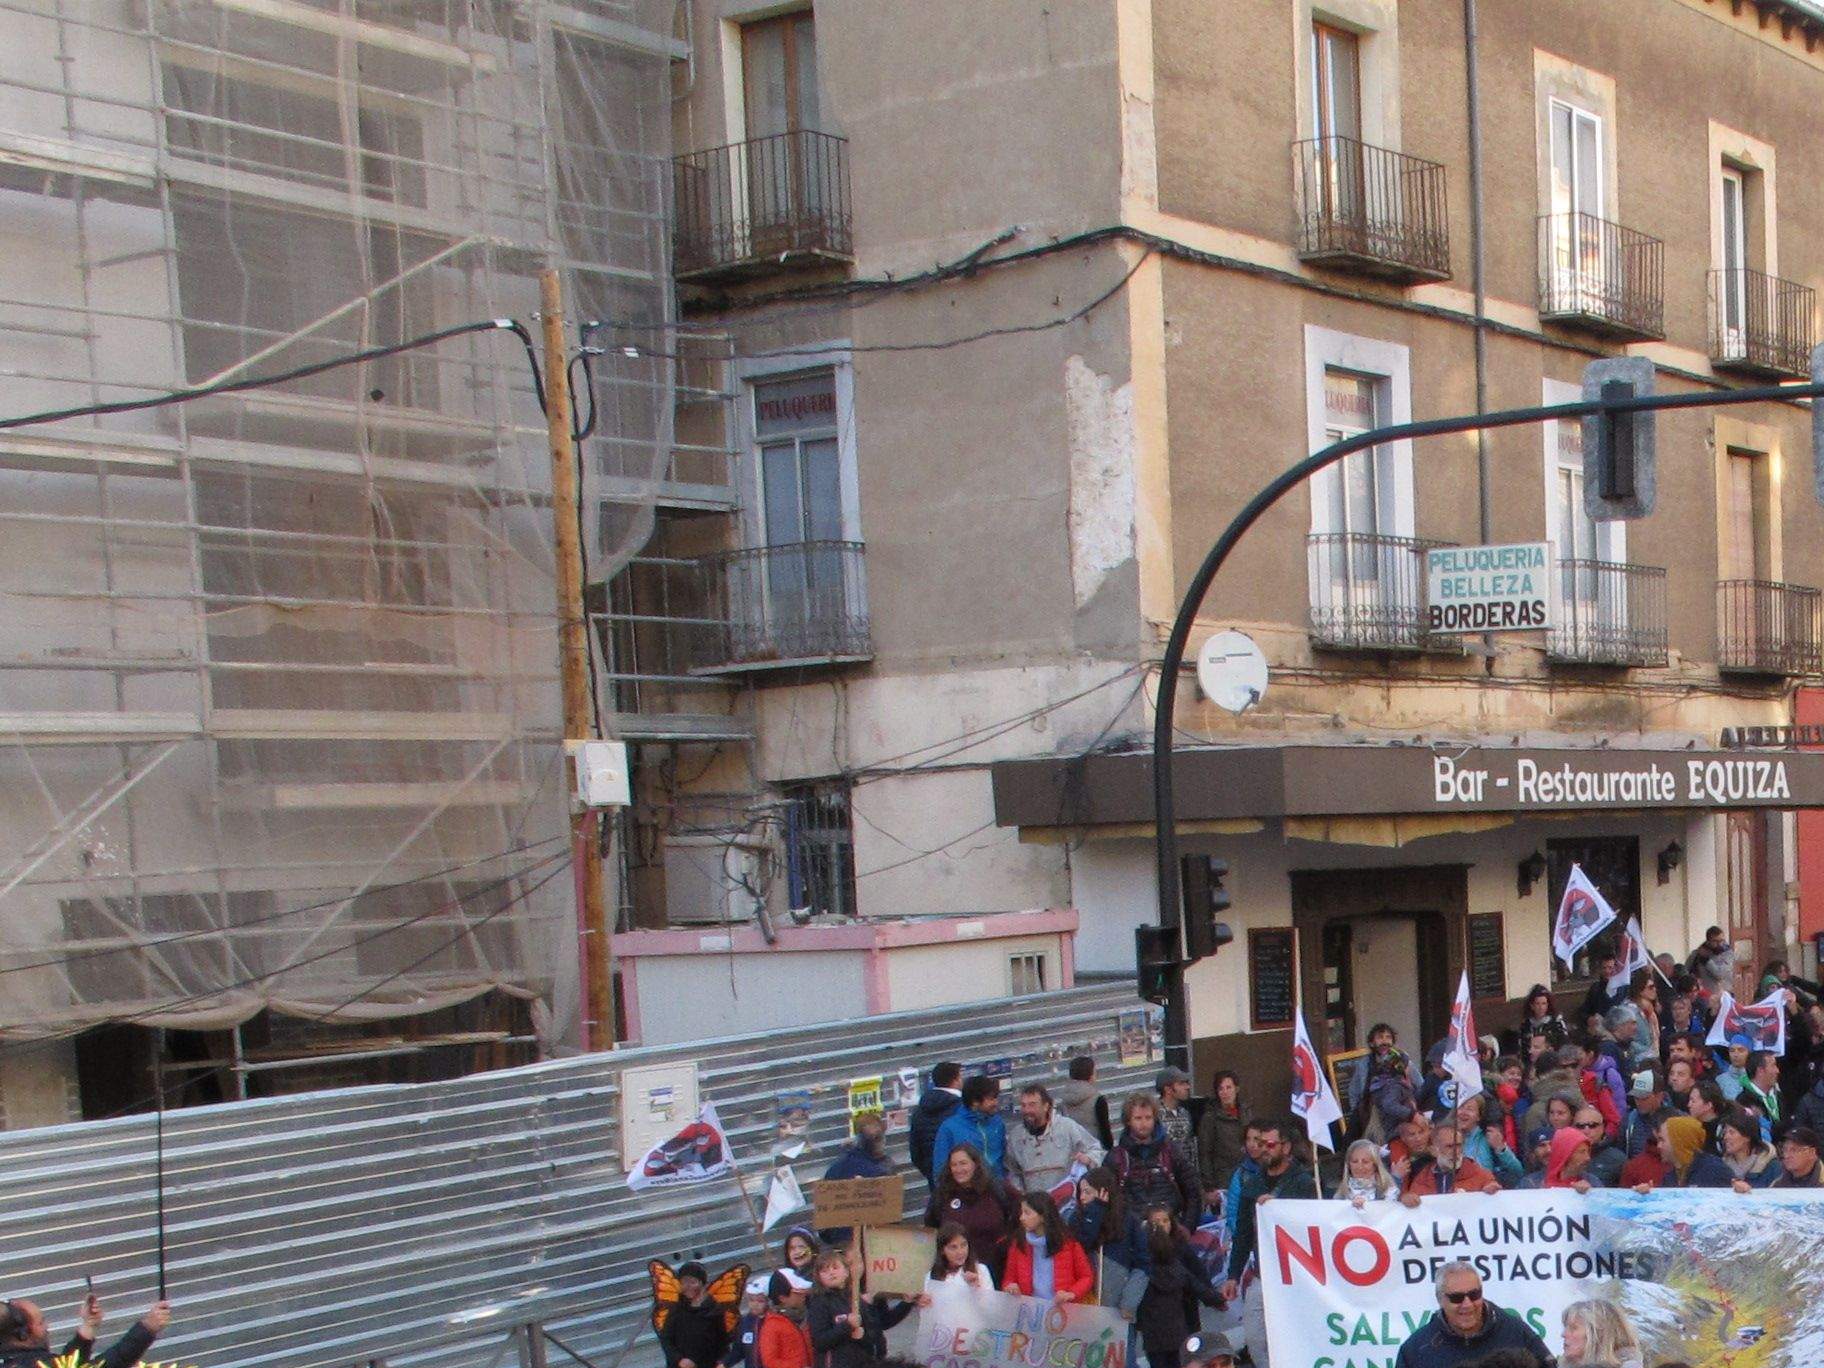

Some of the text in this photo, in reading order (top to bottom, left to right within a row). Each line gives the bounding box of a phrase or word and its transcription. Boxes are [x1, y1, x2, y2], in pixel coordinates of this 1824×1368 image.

[1429, 547, 1545, 573] PELUQUERIA
[1441, 574, 1533, 598] BELLEZA
[1429, 600, 1546, 629] BORDERAS
[1433, 756, 1488, 802] Bar
[1517, 758, 1676, 803] Restaurante
[1687, 760, 1790, 803] EQUIZA
[1400, 1207, 1592, 1250] A LA UNIÓN
[873, 1257, 897, 1272] NO
[1274, 1224, 1391, 1287] NO
[1457, 1251, 1652, 1283] STACIONES
[1014, 1303, 1069, 1335] NO
[1326, 1306, 1547, 1346] SALVS
